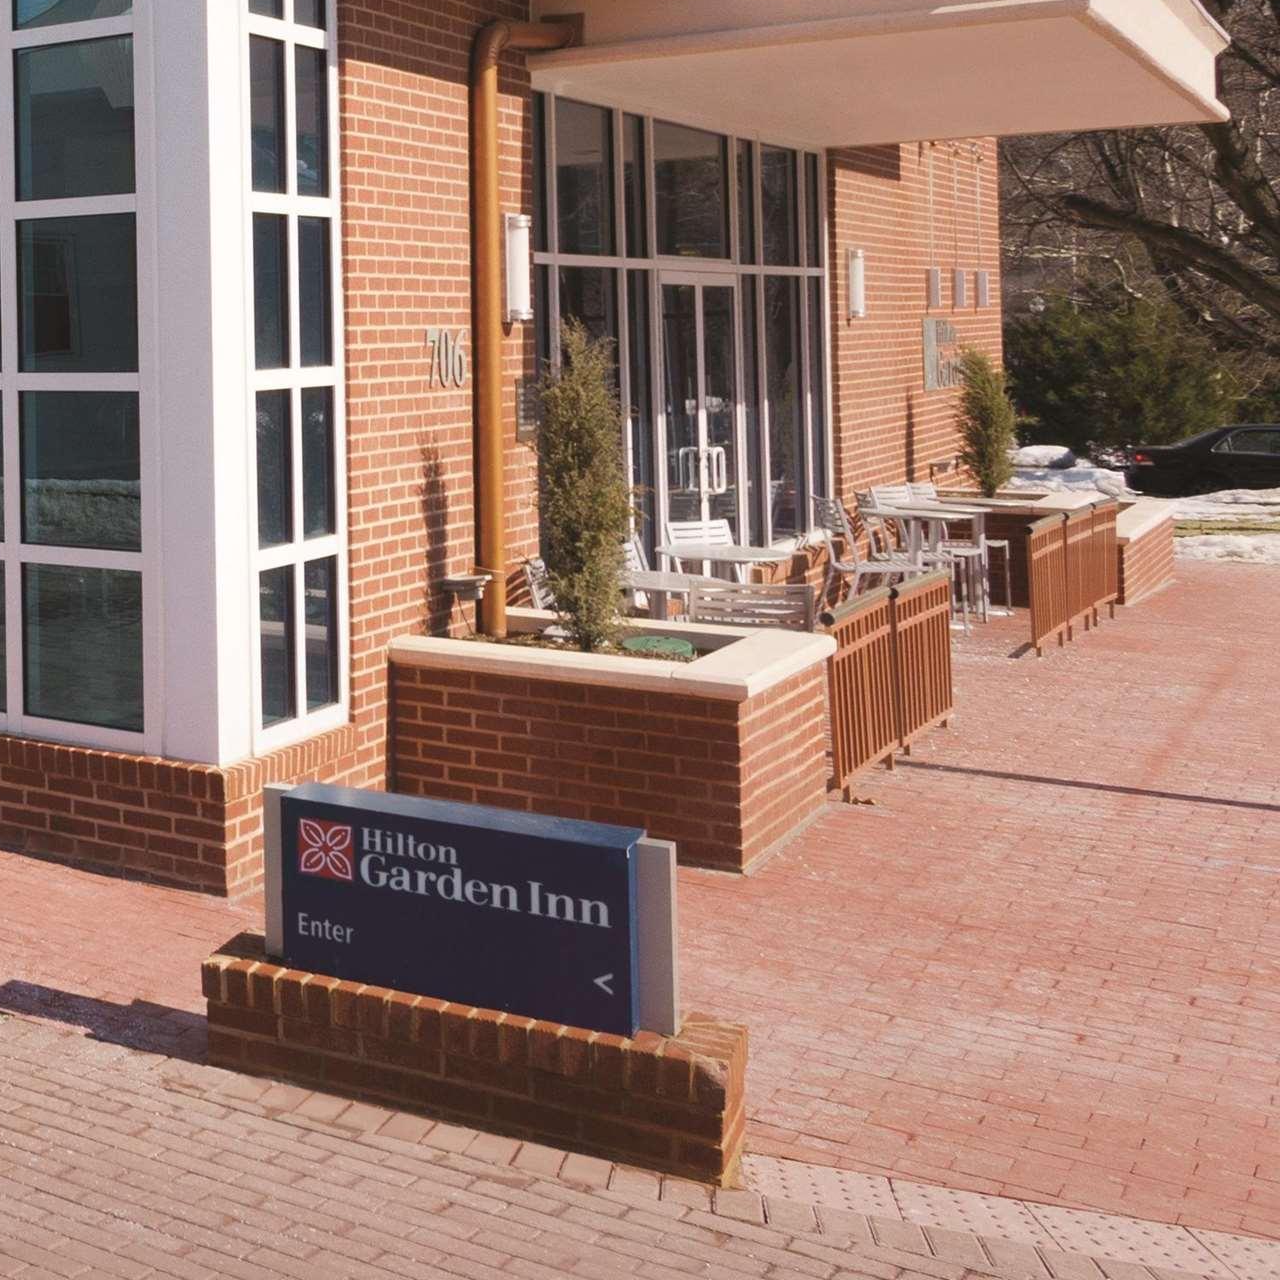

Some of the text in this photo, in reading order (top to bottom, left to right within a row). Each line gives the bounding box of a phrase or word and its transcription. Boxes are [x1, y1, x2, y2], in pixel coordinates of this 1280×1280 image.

[426, 327, 466, 388] 706
[361, 827, 458, 865] Hilton
[360, 853, 612, 928] Garden Inn
[298, 911, 354, 944] Enter
